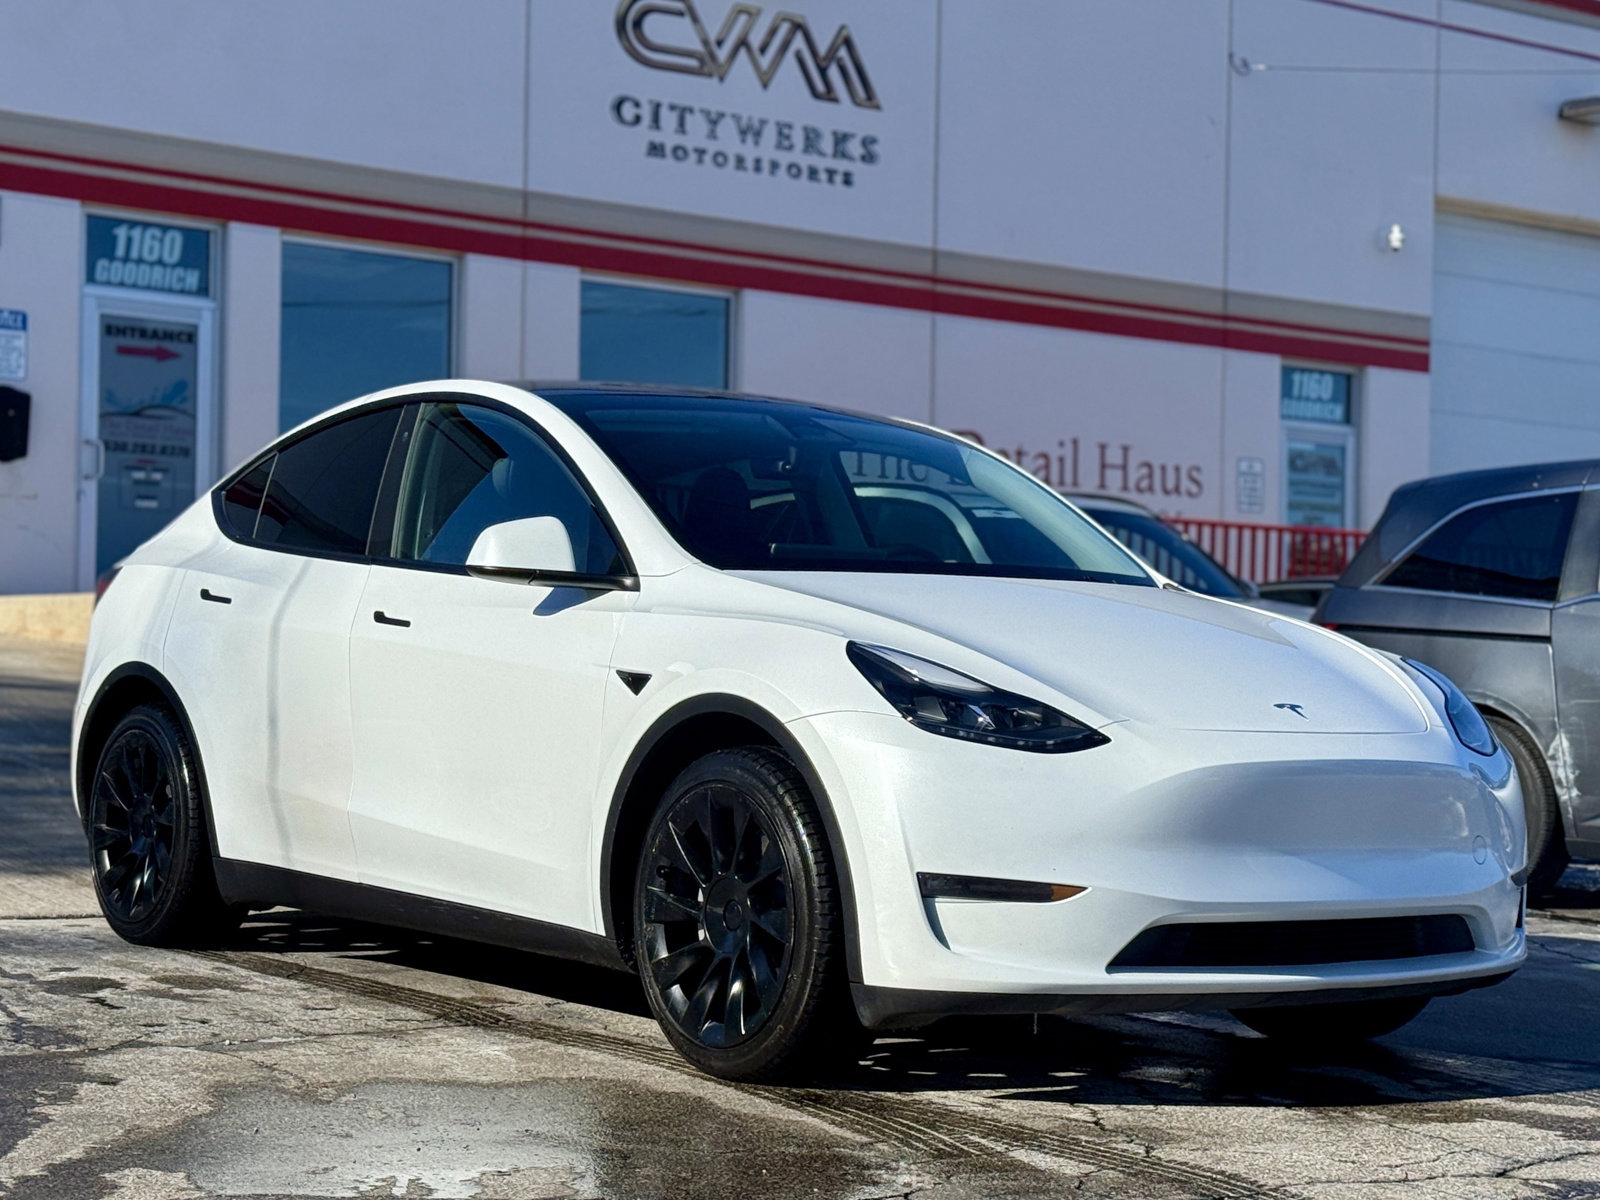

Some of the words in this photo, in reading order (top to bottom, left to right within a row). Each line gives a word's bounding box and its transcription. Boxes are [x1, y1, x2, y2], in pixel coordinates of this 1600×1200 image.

[611, 95, 880, 165] CITYWERKS
[645, 140, 855, 187] MOTORSPORTS
[112, 223, 183, 265] 1160
[94, 258, 200, 292] GOODRICH
[104, 323, 195, 344] ENTRANCE
[1291, 371, 1334, 401] 1160
[1097, 441, 1204, 498] Haus
